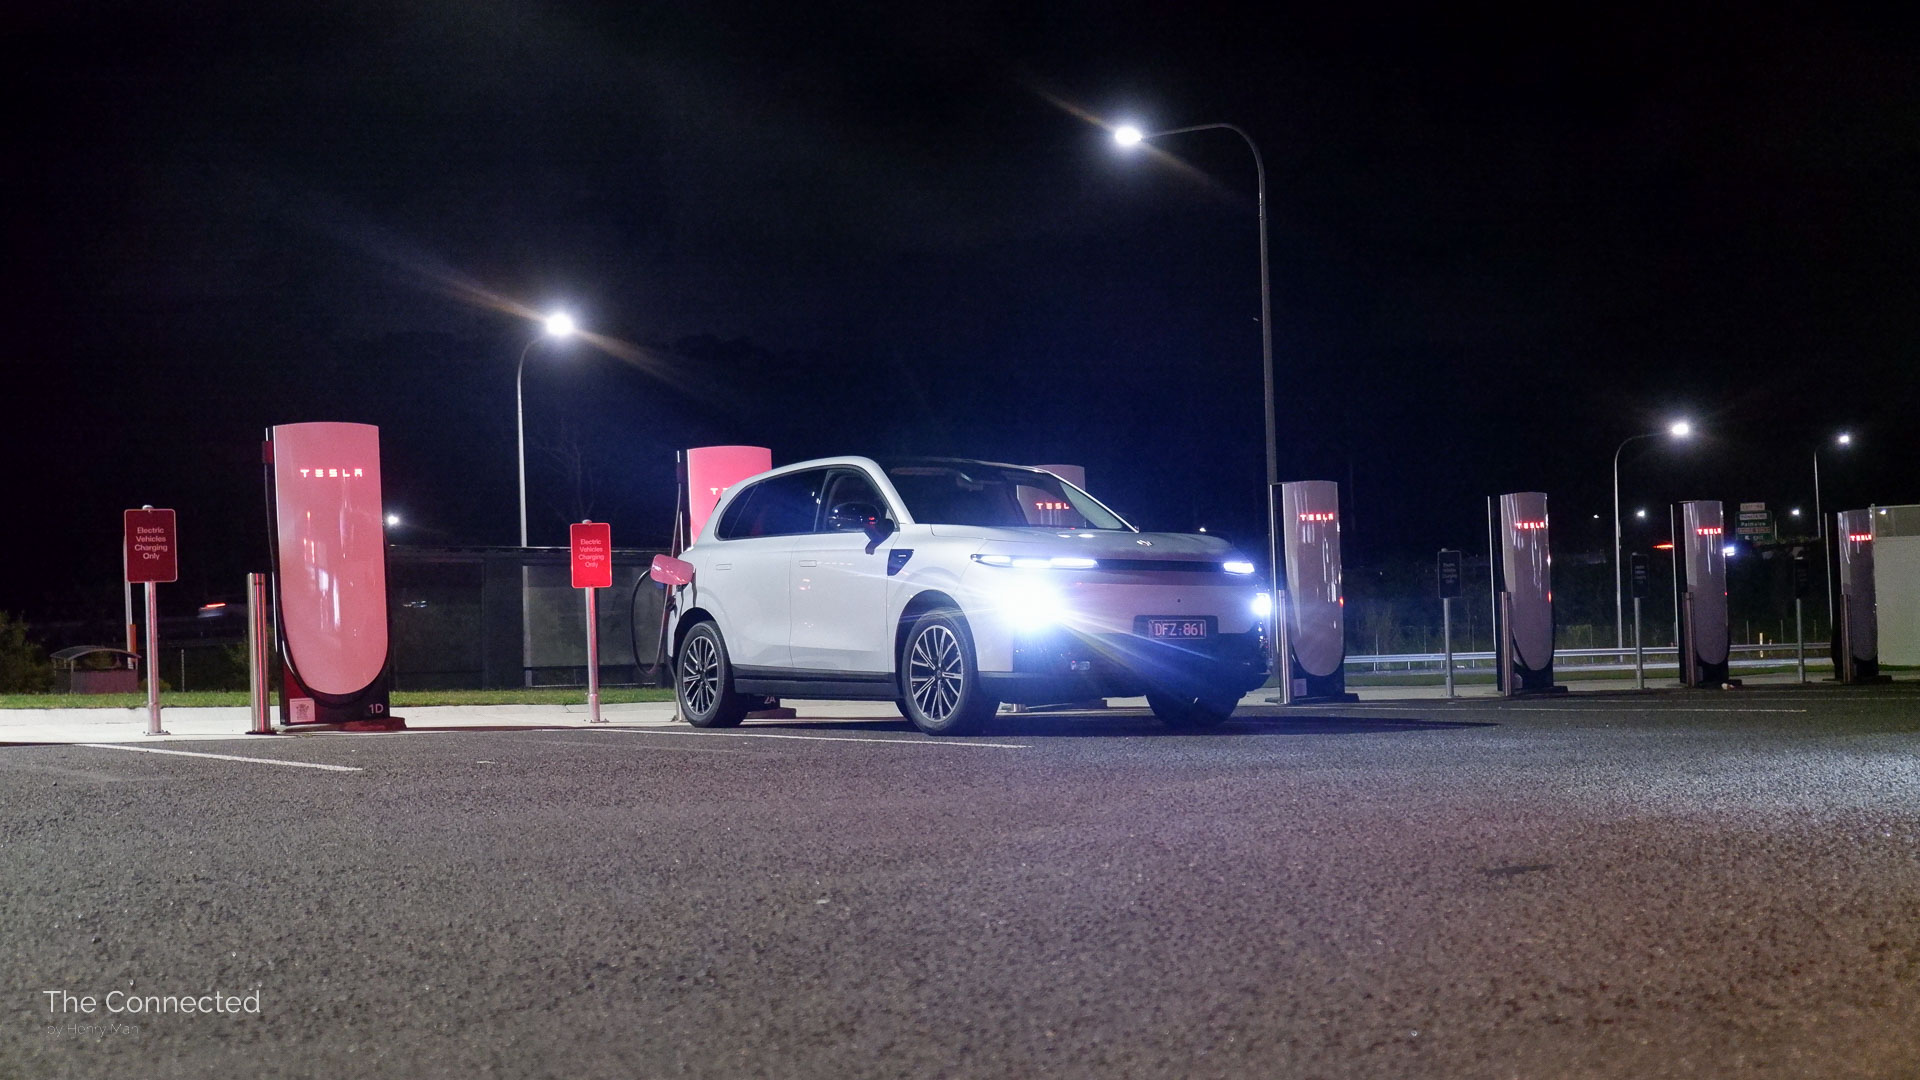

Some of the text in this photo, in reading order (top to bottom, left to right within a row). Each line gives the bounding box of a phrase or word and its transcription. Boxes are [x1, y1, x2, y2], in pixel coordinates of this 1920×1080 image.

[299, 467, 363, 479] TESLA
[1035, 502, 1070, 511] TESL
[1299, 513, 1334, 521] TESLA
[1515, 521, 1545, 530] TESLA
[136, 526, 165, 534] Electric
[135, 535, 167, 543] Vehicles
[134, 544, 168, 552] Charging
[142, 552, 161, 561] Only
[584, 561, 600, 569] Only
[367, 703, 385, 715] 1D
